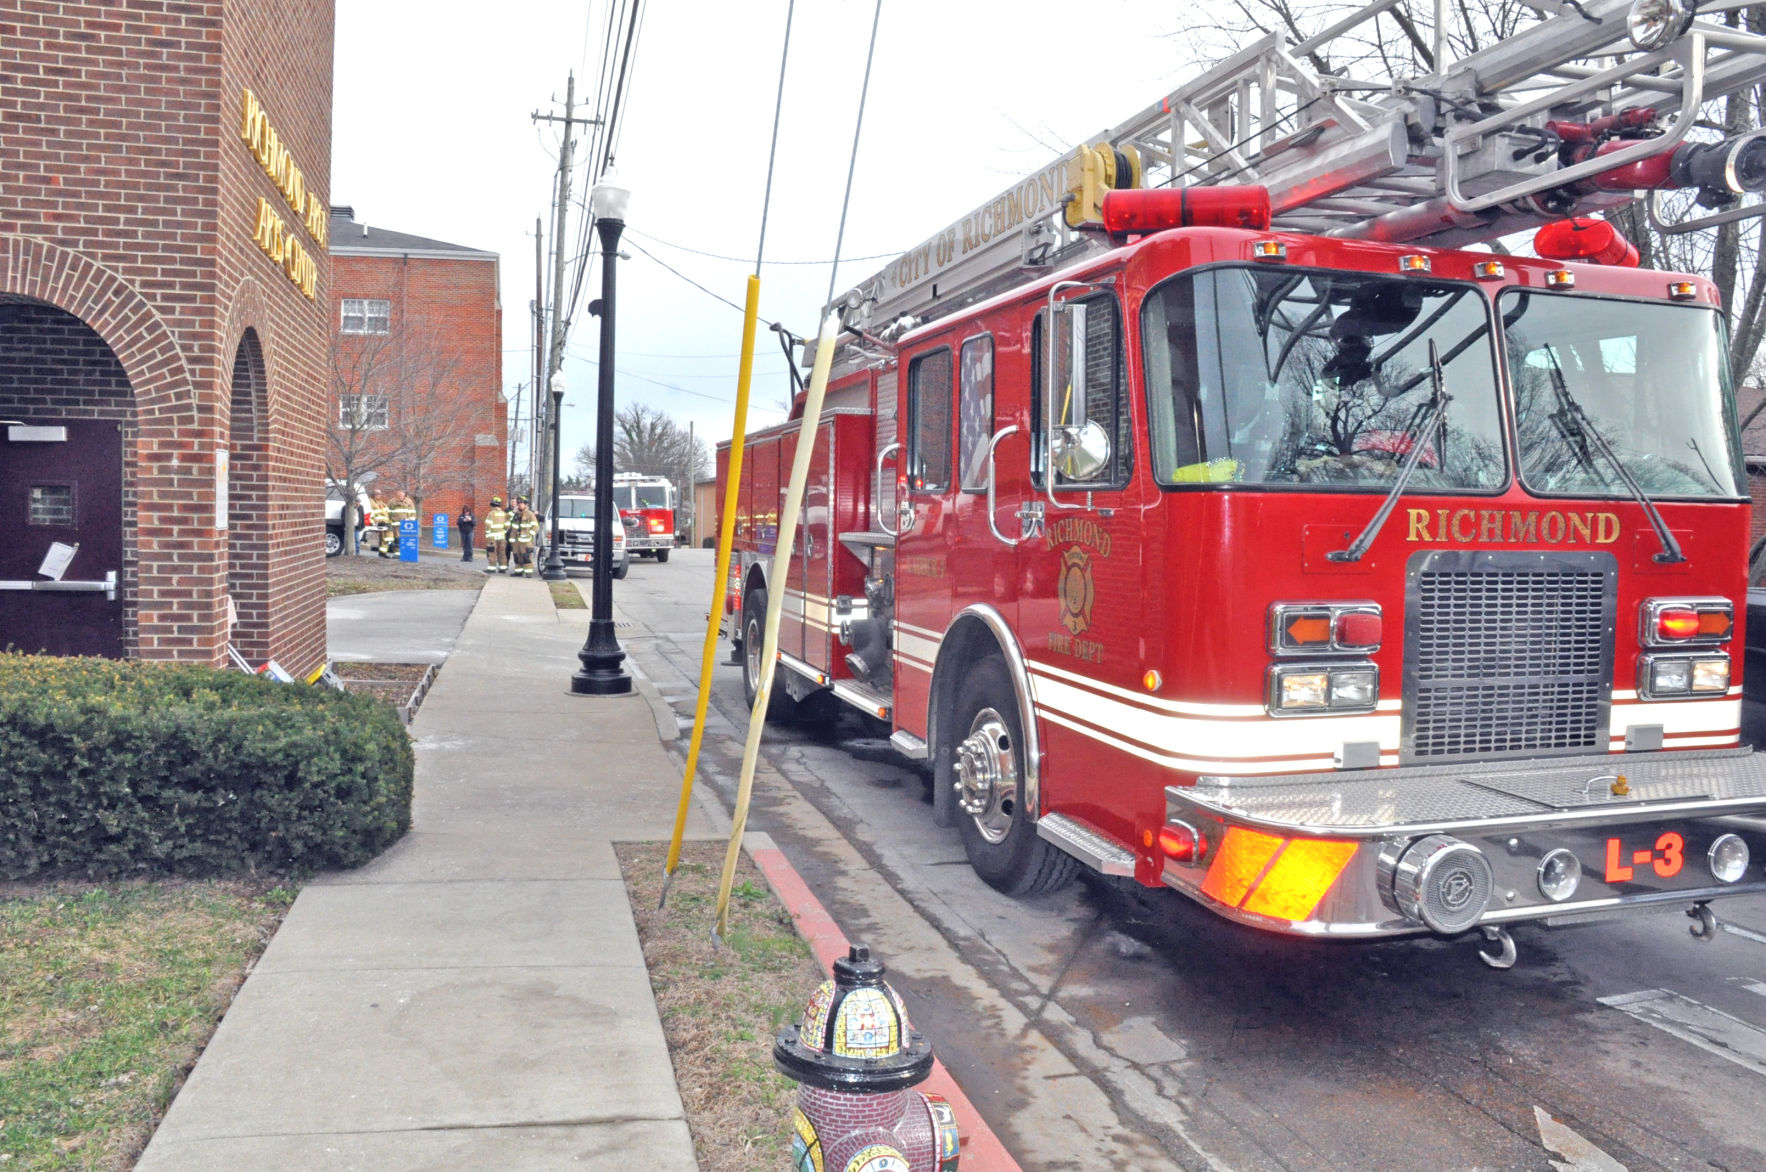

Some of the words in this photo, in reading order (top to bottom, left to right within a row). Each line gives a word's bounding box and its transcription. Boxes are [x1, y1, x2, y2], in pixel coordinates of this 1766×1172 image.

[242, 88, 304, 214] RICHMOND
[253, 196, 284, 264] ARTS
[899, 242, 931, 288] CITY
[936, 227, 955, 267] OF
[961, 159, 1069, 254] RICHMOND
[1045, 517, 1112, 558] RICHMOND
[1406, 508, 1621, 544] RICHMOND
[1048, 632, 1071, 655] FIRE
[1074, 638, 1104, 664] DEPT
[1605, 832, 1684, 883] L-3
